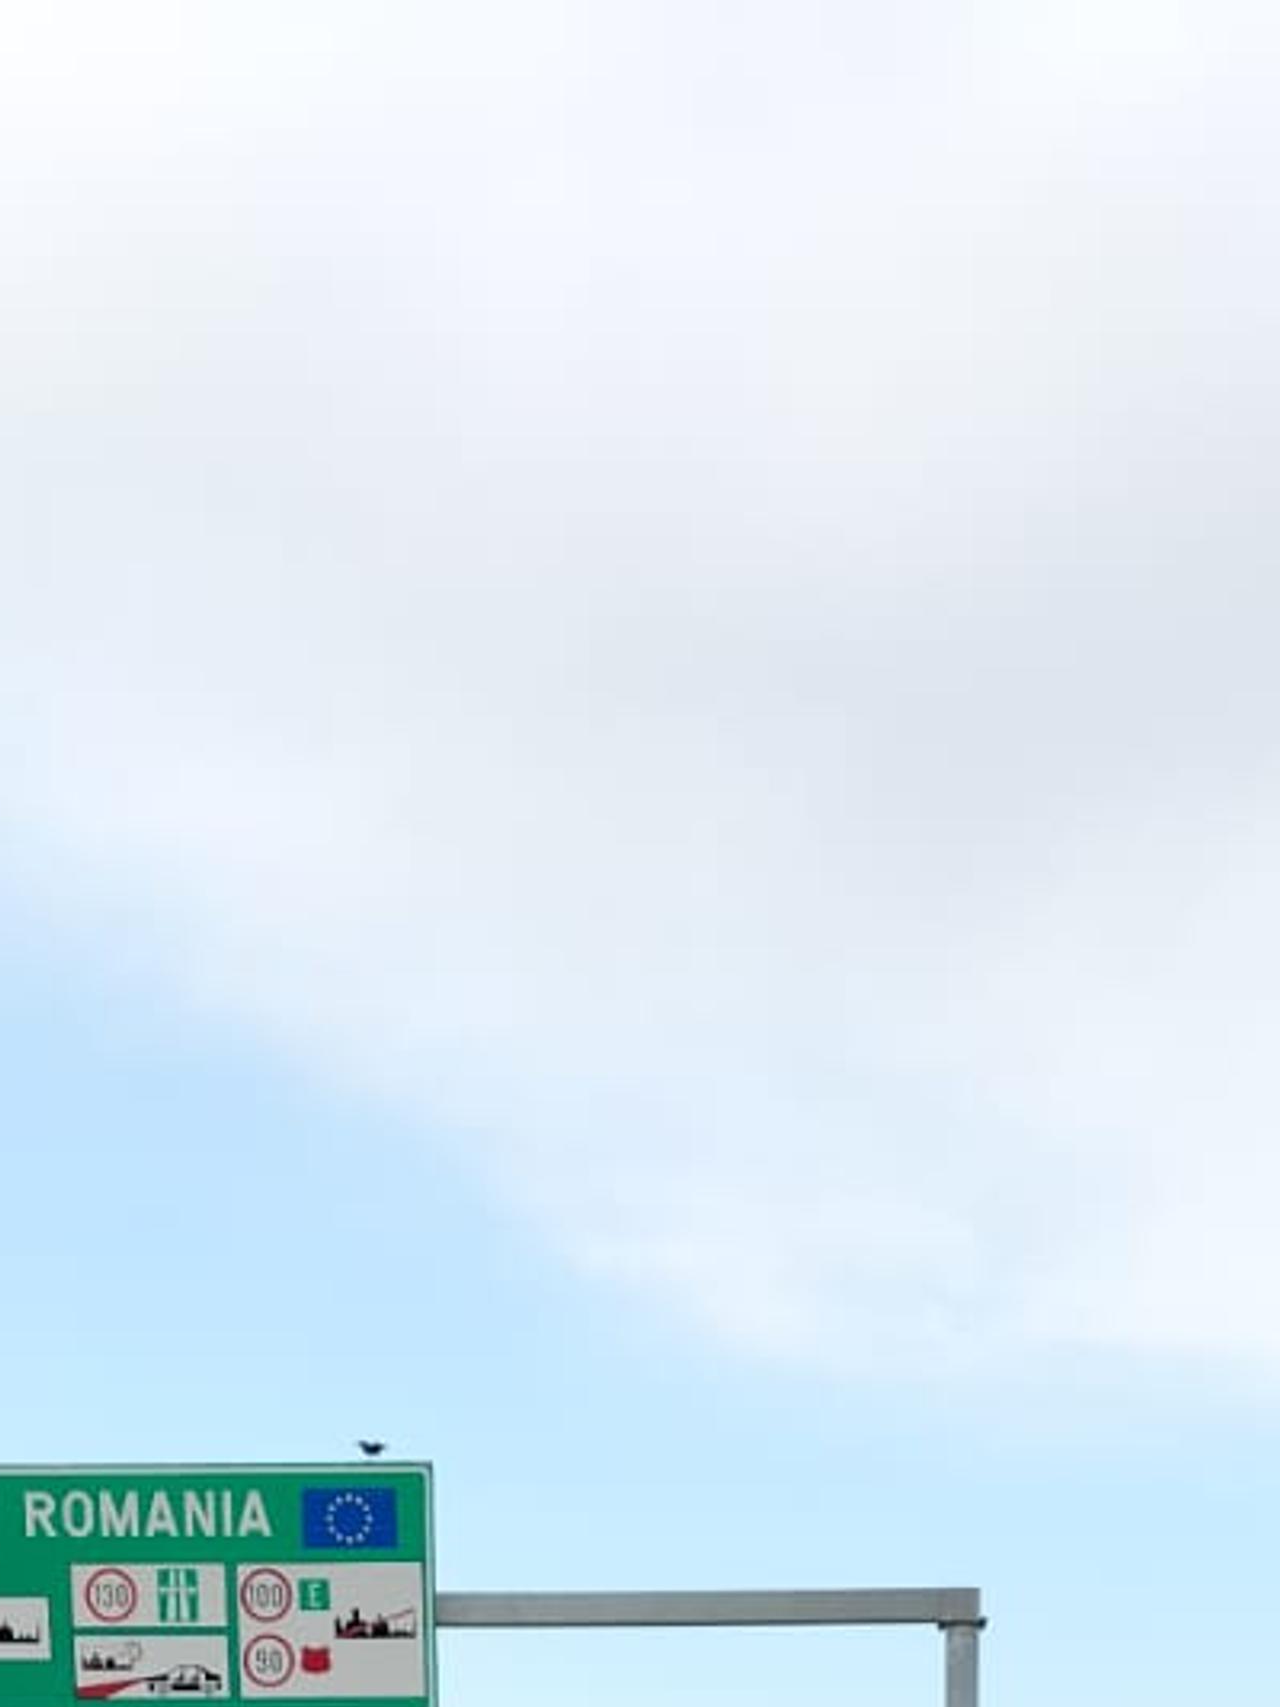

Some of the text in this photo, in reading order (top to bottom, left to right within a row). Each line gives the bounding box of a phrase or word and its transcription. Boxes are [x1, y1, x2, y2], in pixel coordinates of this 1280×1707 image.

[24, 1489, 272, 1538] ROMANIA
[94, 1584, 128, 1608] 130
[248, 1584, 283, 1607] 100
[308, 1584, 320, 1605] E
[255, 1649, 282, 1673] 90
